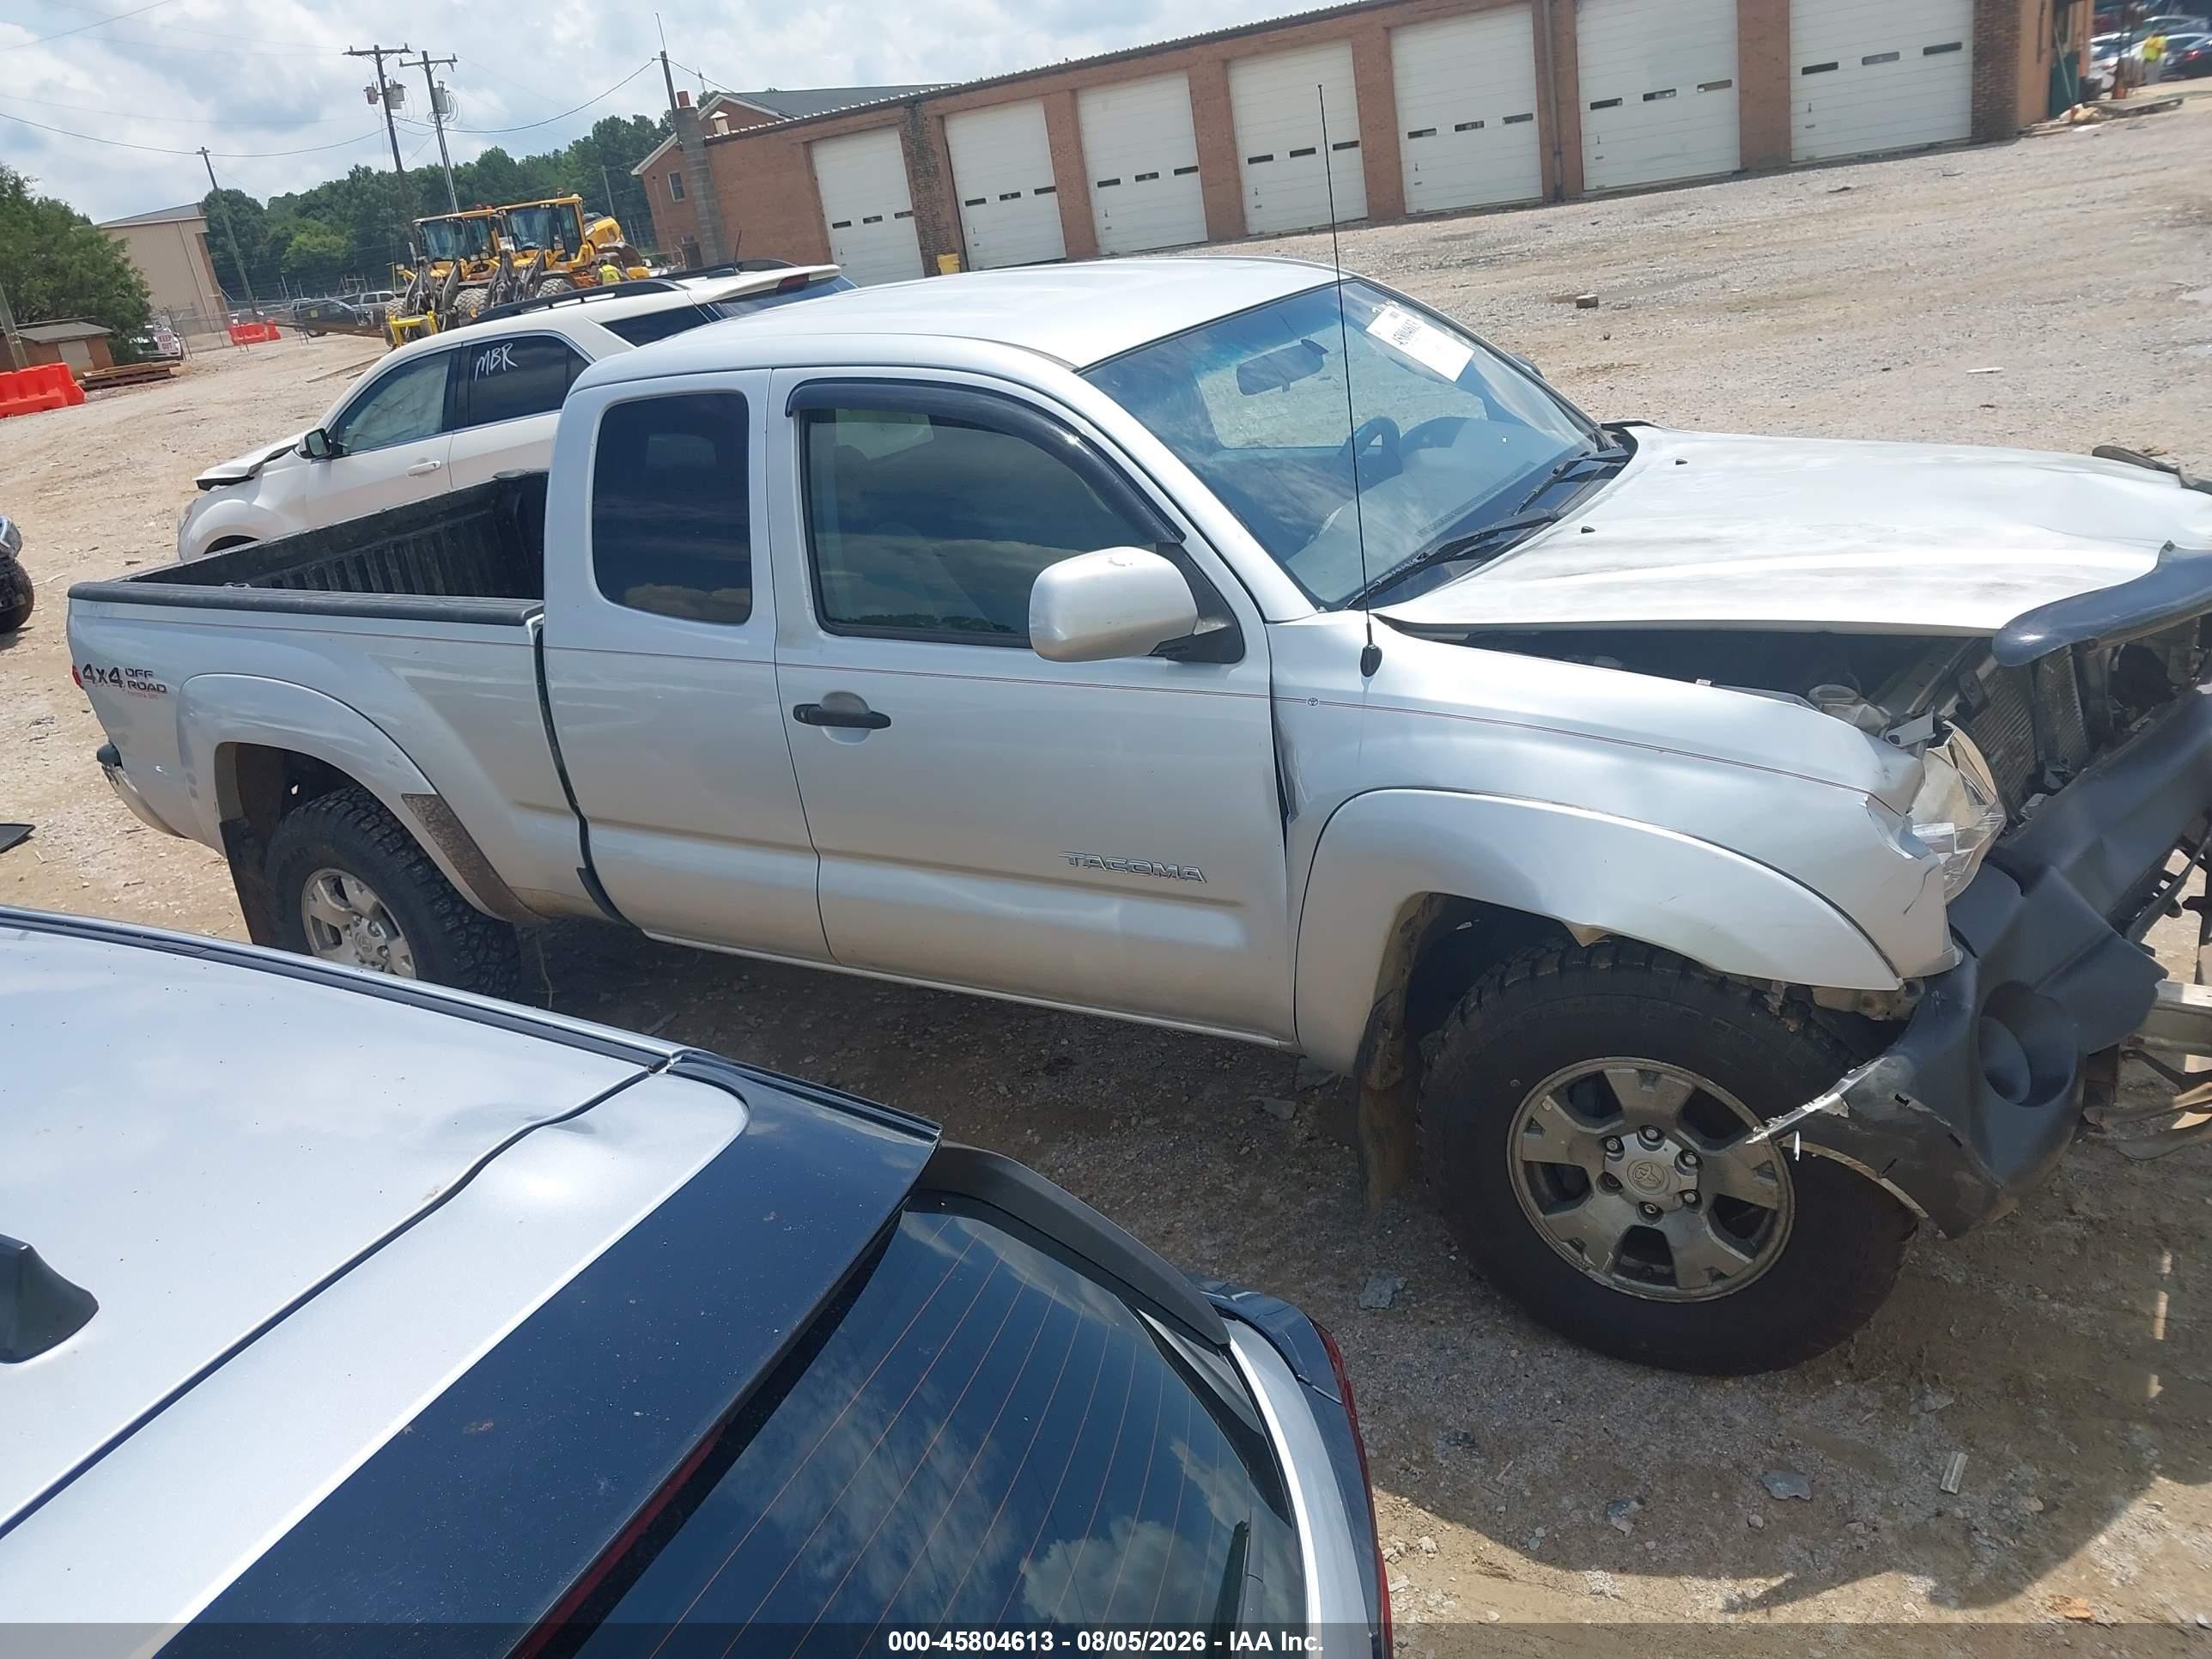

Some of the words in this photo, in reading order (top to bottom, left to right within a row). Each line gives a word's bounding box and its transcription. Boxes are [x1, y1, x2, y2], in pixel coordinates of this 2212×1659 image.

[474, 343, 519, 382] MBR
[125, 668, 154, 678] OFF
[127, 681, 167, 694] ROAD
[1059, 851, 1207, 884] TACOMA
